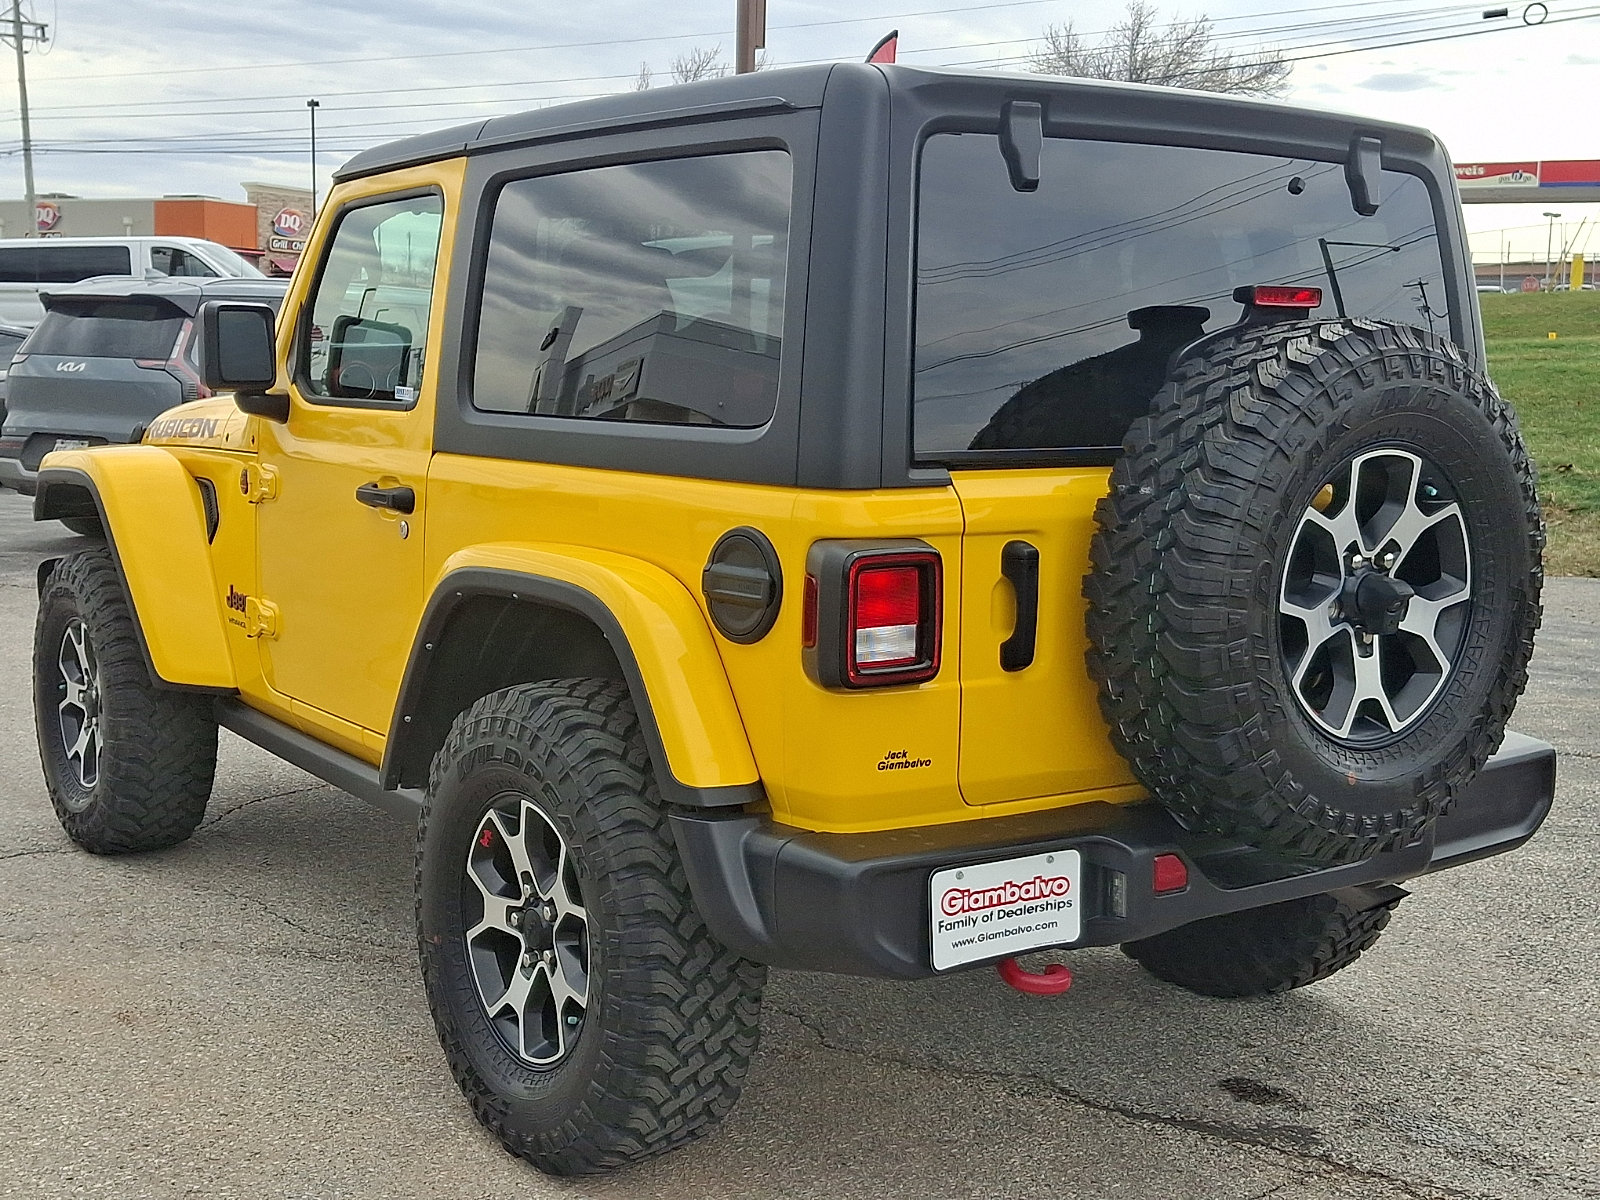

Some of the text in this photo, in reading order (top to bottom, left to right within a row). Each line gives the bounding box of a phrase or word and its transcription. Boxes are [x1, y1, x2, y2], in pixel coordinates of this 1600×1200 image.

[280, 214, 300, 231] DQ
[273, 240, 288, 249] Grill
[150, 417, 220, 438] RUBICON
[884, 749, 908, 760] Jack
[877, 758, 932, 771] Giambalvo
[941, 875, 1070, 916] Giambalvo
[938, 899, 1073, 934] Family of Dealerships
[951, 921, 1058, 949] www.Giambalvo.com
